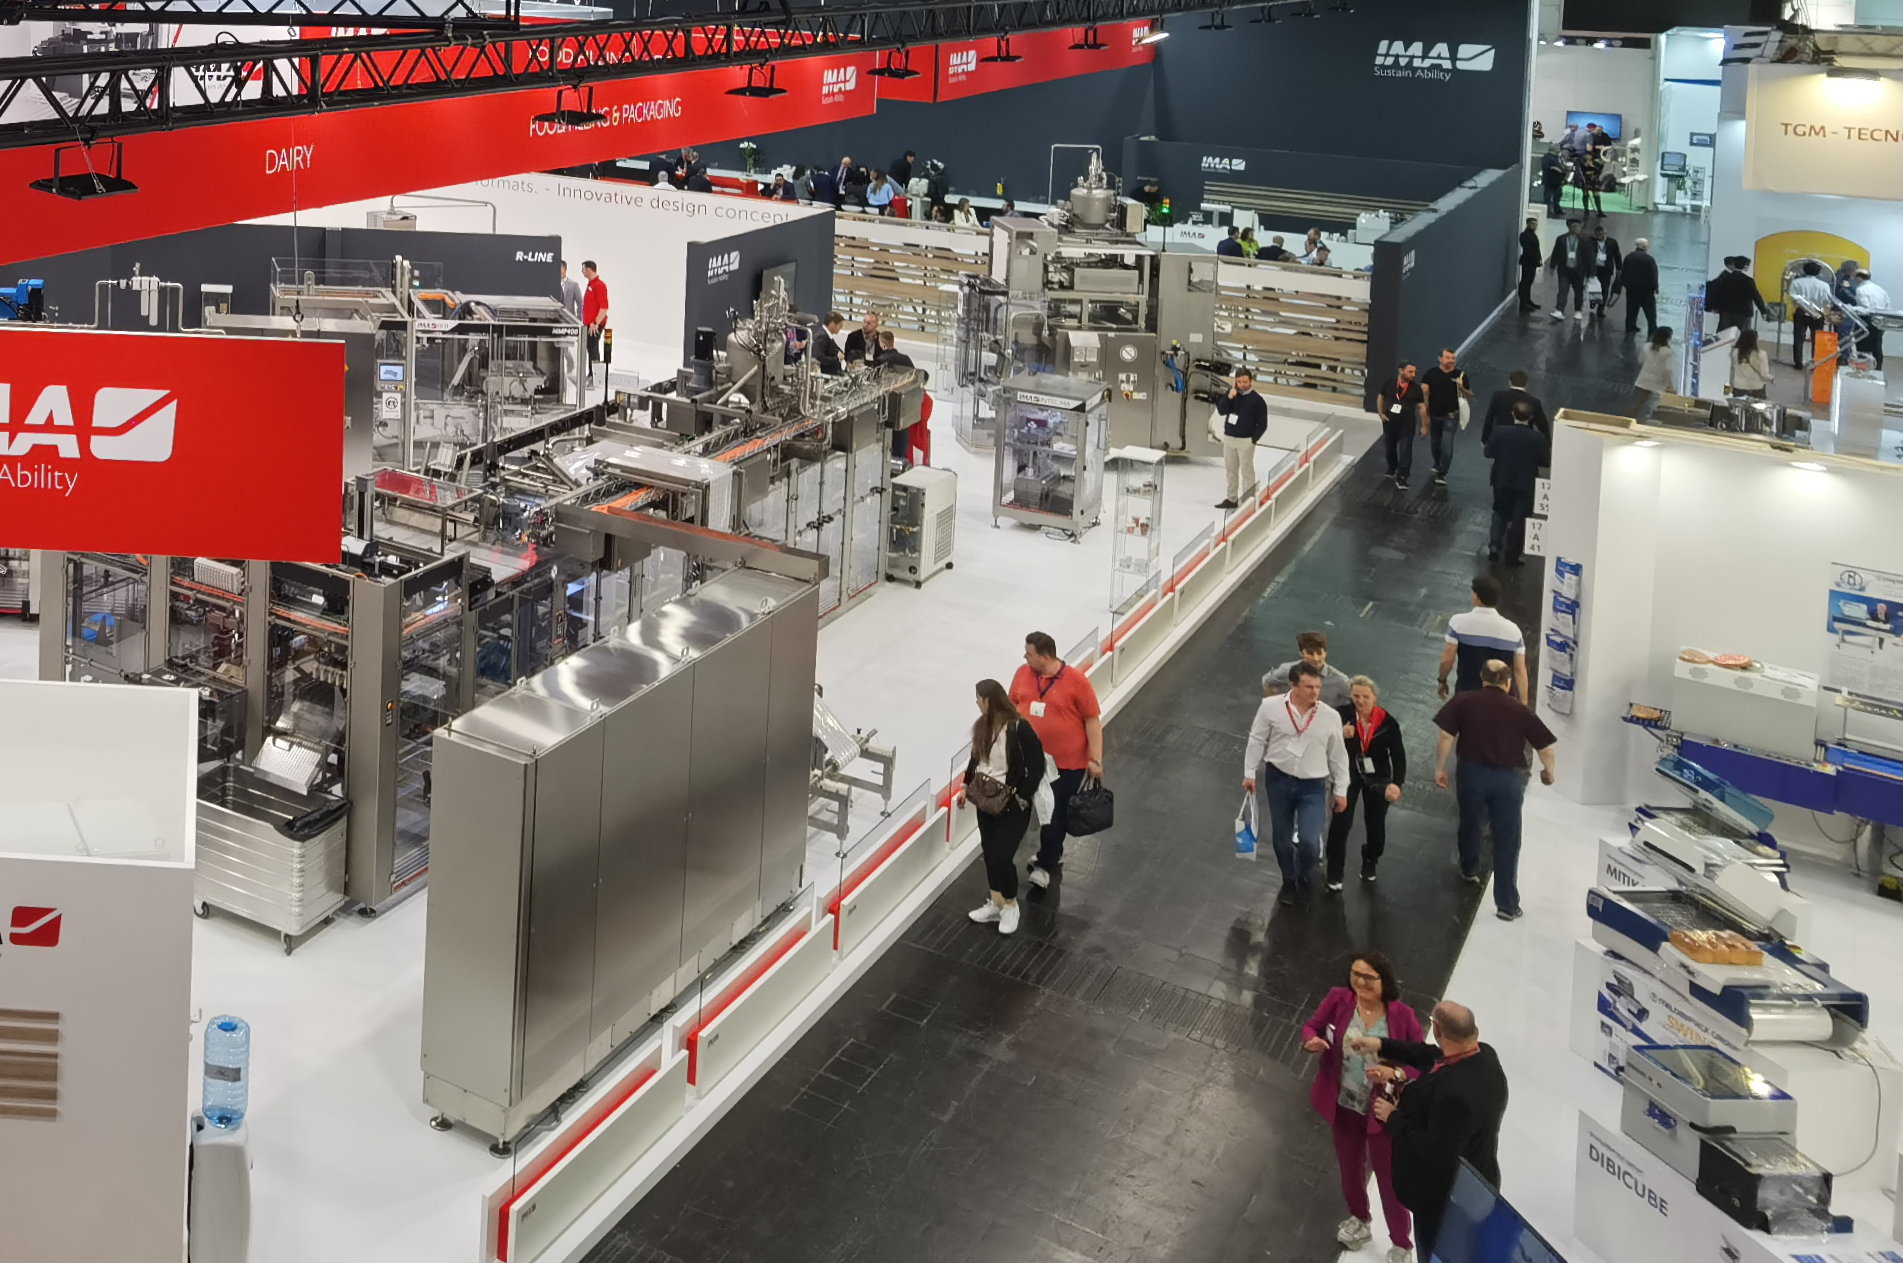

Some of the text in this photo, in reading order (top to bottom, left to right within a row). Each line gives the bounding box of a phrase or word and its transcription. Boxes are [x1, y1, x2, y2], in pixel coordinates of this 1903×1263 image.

[1375, 39, 1453, 69] IMA
[1374, 67, 1452, 83] Sustain Ability
[622, 97, 682, 124] PACKAGING
[1780, 122, 1827, 138] TGM
[1843, 126, 1903, 143] TECN
[265, 144, 314, 175] DAIRY
[1201, 156, 1230, 169] IMA
[557, 182, 644, 208] Innovative
[650, 194, 707, 217] design
[515, 251, 554, 263] R-LINE
[707, 253, 729, 278] IMA
[1532, 522, 1542, 530] 17
[1533, 533, 1540, 541] A
[1529, 544, 1540, 552] 41
[1589, 1143, 1669, 1217] DIBICUBE
